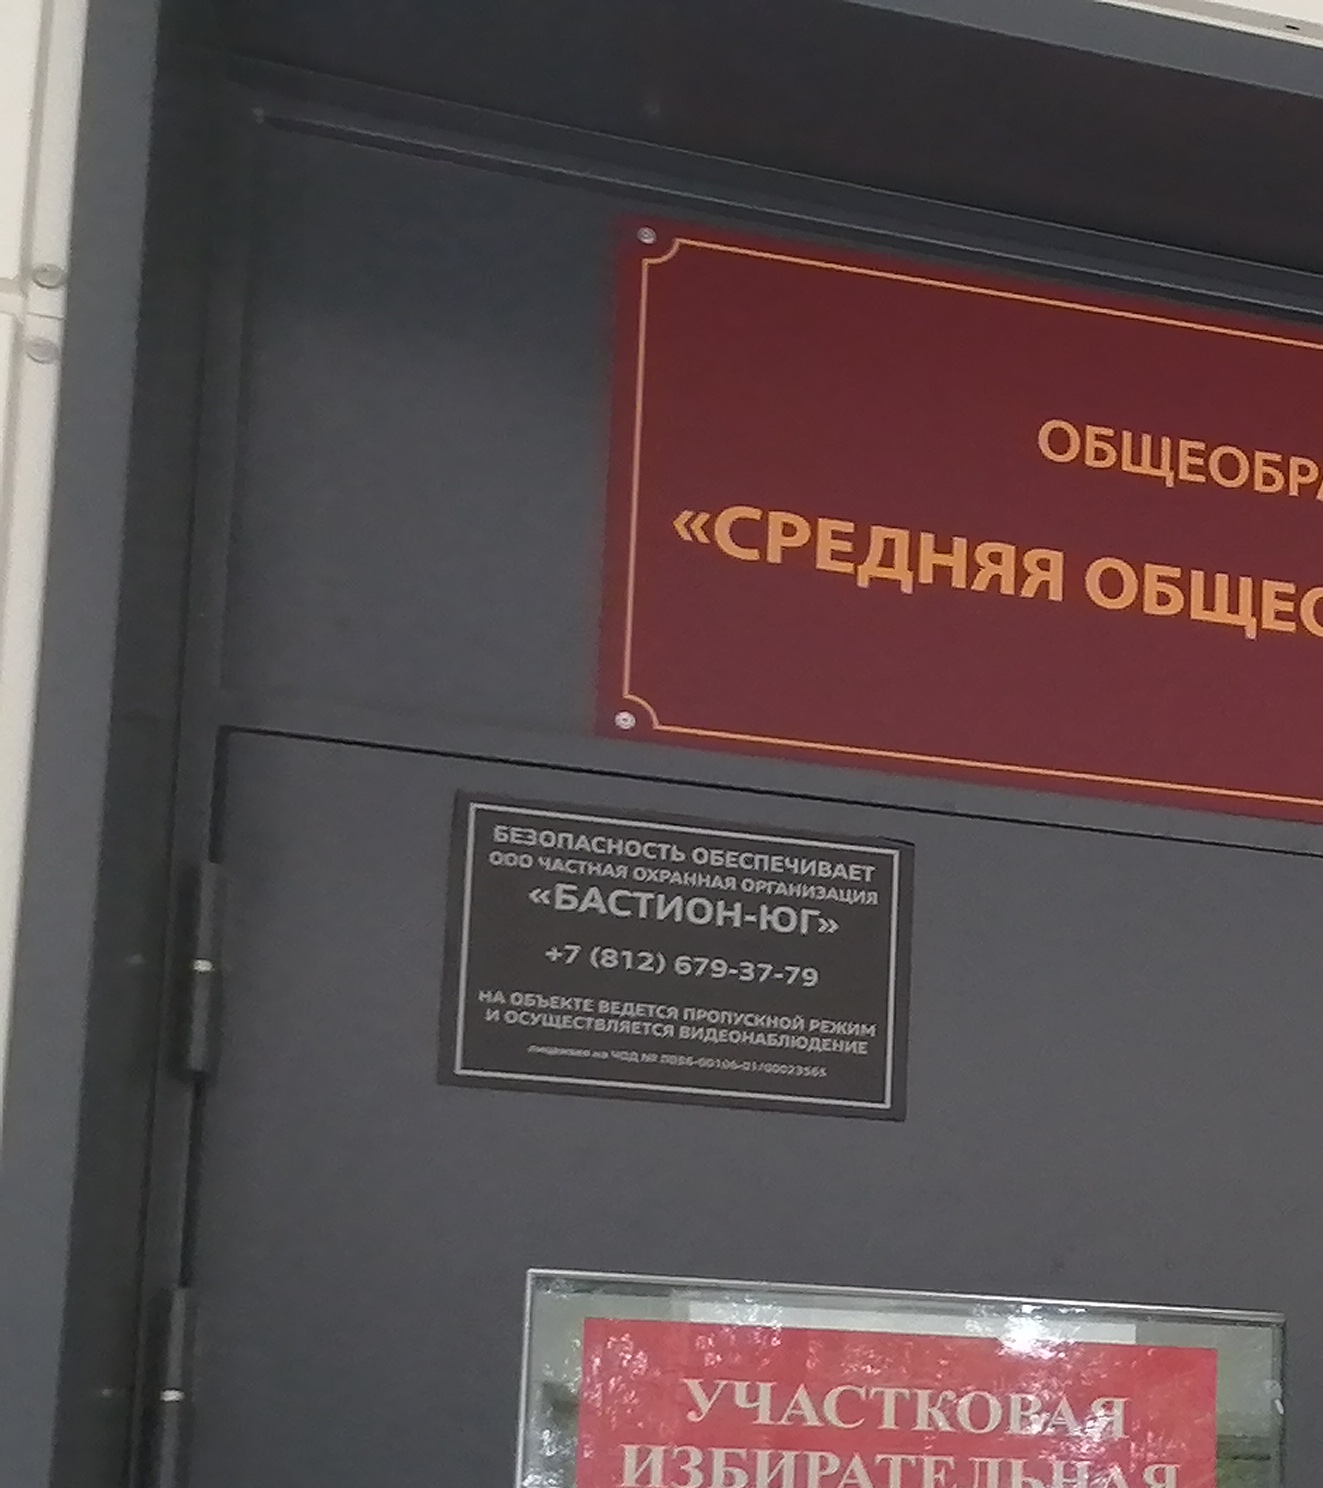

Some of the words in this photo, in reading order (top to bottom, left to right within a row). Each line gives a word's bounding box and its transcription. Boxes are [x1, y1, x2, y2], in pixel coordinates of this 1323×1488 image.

[673, 505, 1064, 602] «СРЕДНЯЯ
[489, 851, 533, 869] ООО
[538, 856, 628, 880] ЧАСТНАЯ
[632, 866, 736, 892] ОХРАННАЯ
[741, 876, 878, 905] ОРГАНИЗАЦИЯ
[492, 825, 686, 862] БЕЗОПАСНОСТЬ
[692, 847, 875, 883] ОБЕСПЕЧИВАЕТ
[529, 882, 839, 935] «БАСТИОН-ЮГ»
[546, 944, 581, 965] +7
[589, 947, 667, 975] (812)
[675, 956, 819, 987] 679-37-79
[478, 990, 505, 1005] НА
[510, 991, 594, 1012] ОБЪЕКТЕ
[598, 1000, 679, 1020] ВЕДЕТСЯ
[683, 1006, 804, 1032] ПРОПУСКНОЙ
[809, 1019, 877, 1036] РЕЖИМ
[485, 1008, 500, 1021] И
[504, 1009, 674, 1038] ОСУЩЕСТВЛЯЕТСЯ
[679, 1025, 868, 1055] ВИДЕОНАБЛЮДЕНИЕ
[682, 1377, 1129, 1440] УЧАСТКОВАЯ
